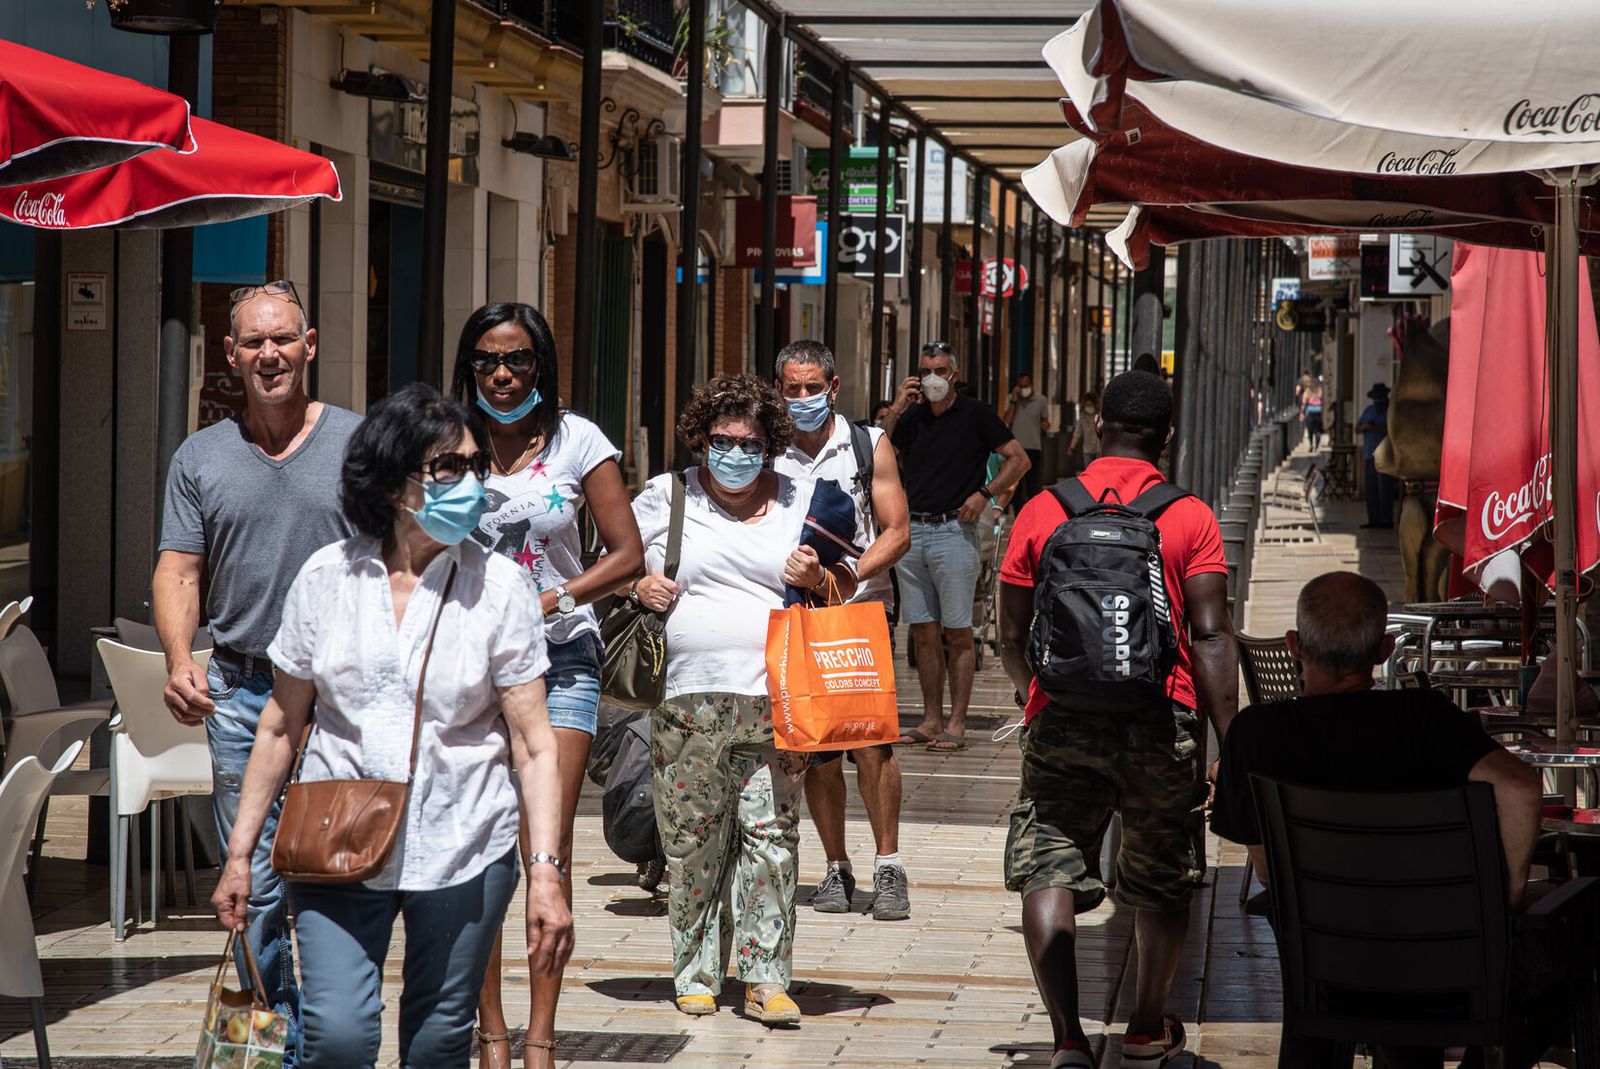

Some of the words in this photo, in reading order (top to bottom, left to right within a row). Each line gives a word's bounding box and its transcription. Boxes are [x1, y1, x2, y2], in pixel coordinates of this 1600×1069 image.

[1376, 149, 1461, 175] Coca-Cola
[13, 190, 69, 226] Coca-Cola
[848, 195, 891, 206] DIETETIO
[746, 247, 804, 257] PROVIAS
[1481, 452, 1553, 541] Coca-C
[482, 500, 537, 534] IFORNIA
[1101, 594, 1132, 677] SPORT
[812, 646, 876, 670] PRECCHIO
[778, 618, 793, 735] www.precchio.com
[823, 679, 854, 690] COLORS
[855, 678, 881, 689] CONCEPT
